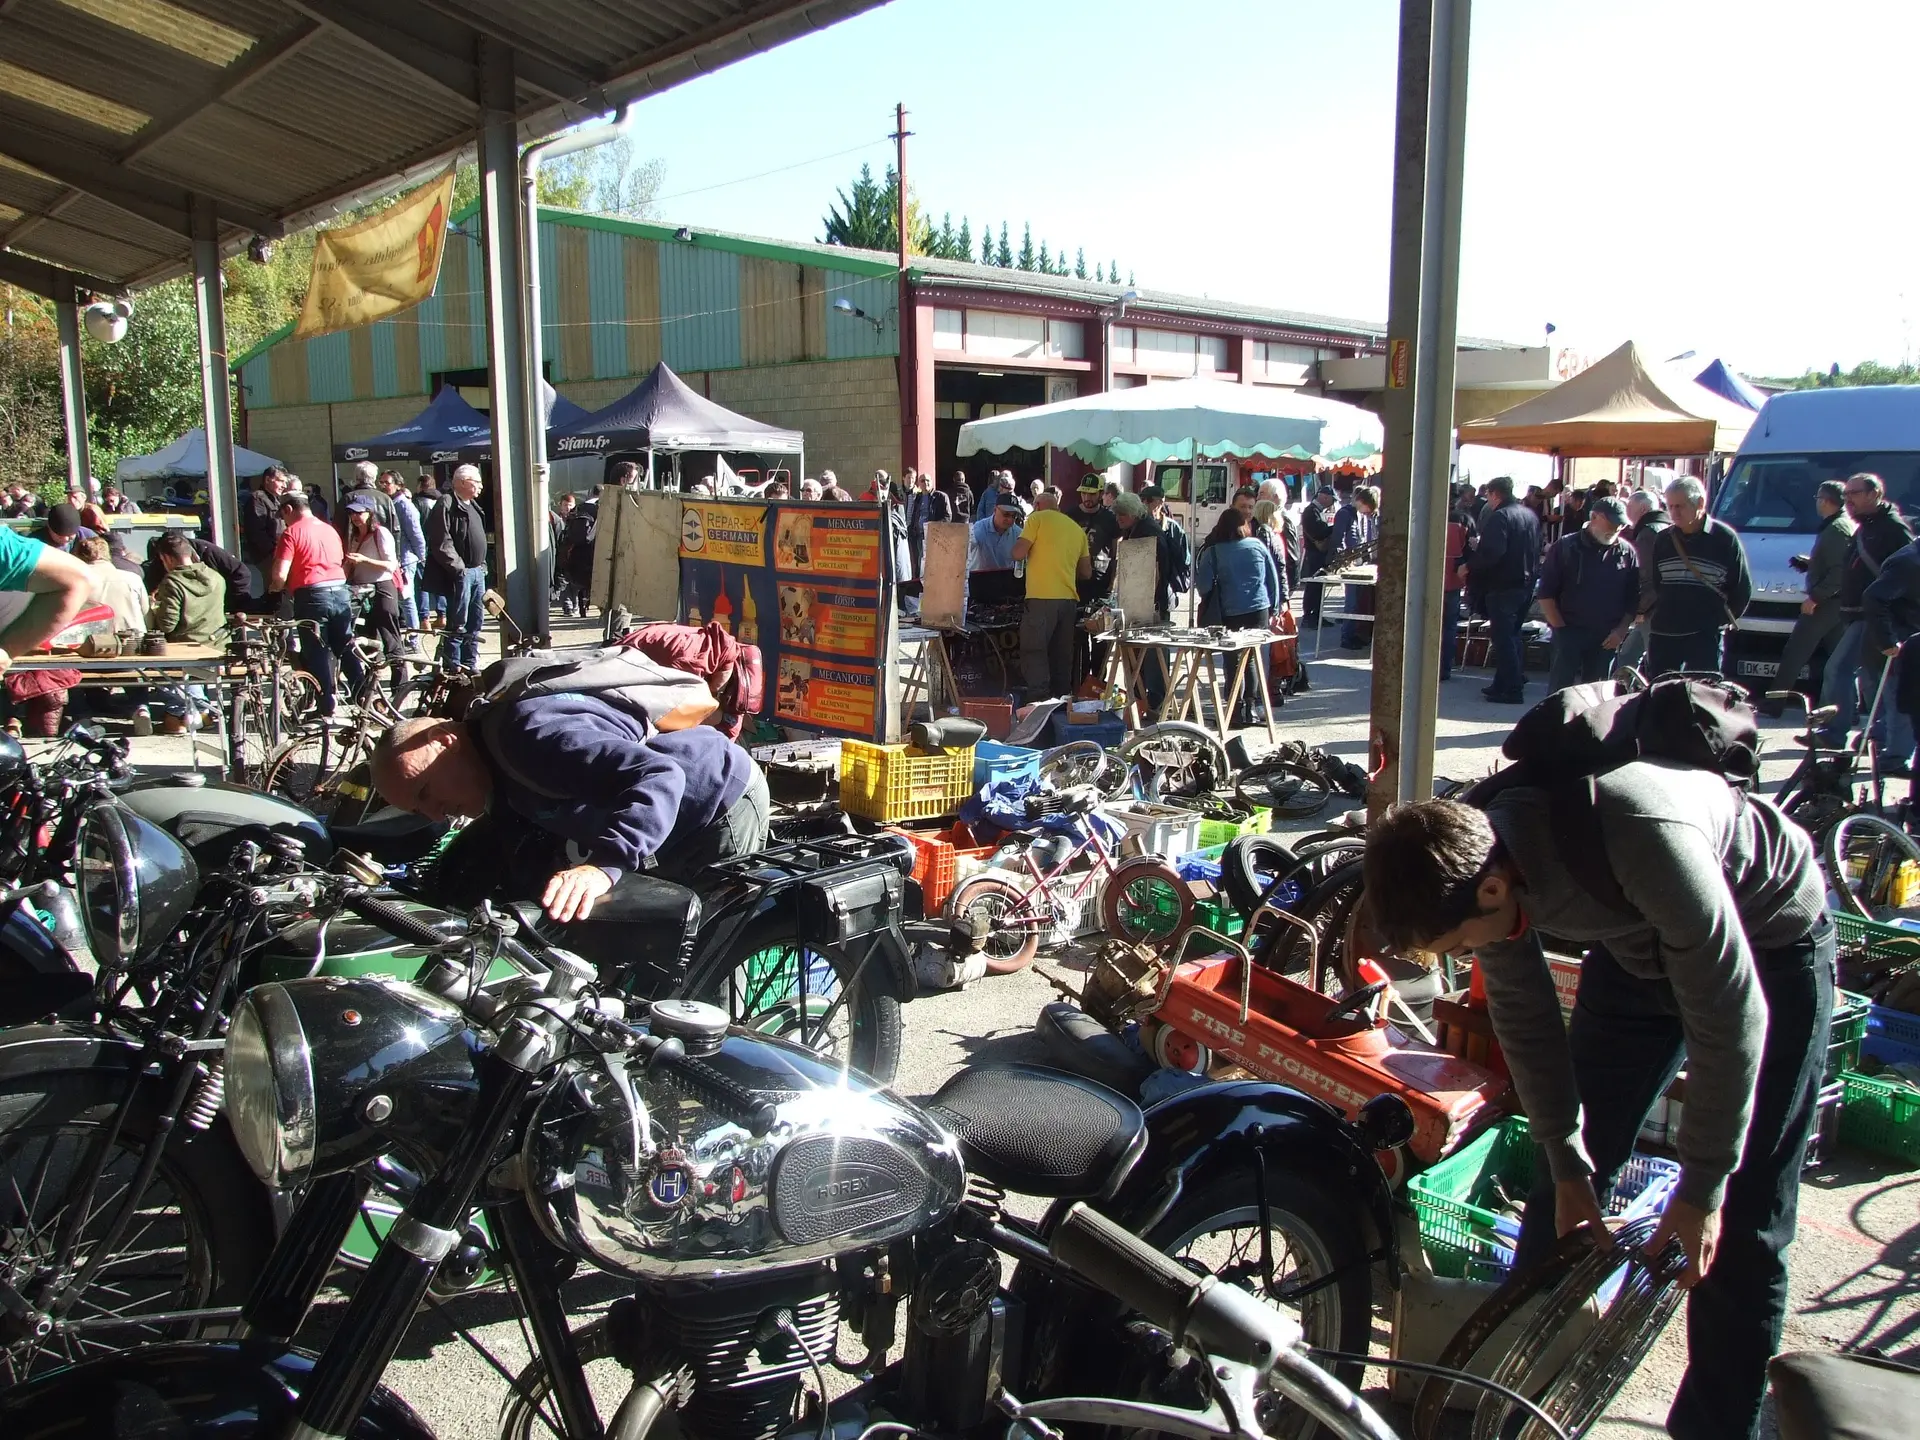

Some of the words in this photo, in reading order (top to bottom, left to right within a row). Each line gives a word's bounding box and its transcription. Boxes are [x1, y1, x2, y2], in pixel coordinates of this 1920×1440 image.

[557, 435, 610, 451] Sifam.fr
[827, 518, 865, 530] MENAGE
[708, 529, 758, 543] GERMANY
[834, 595, 856, 607] LOISIR
[818, 669, 872, 686] MECANIQUE
[1549, 968, 1580, 992] supe
[1191, 1008, 1247, 1048] FIRE
[1256, 1042, 1368, 1106] FIGHTER
[660, 1171, 681, 1197] H
[817, 1176, 870, 1199] HOREX
